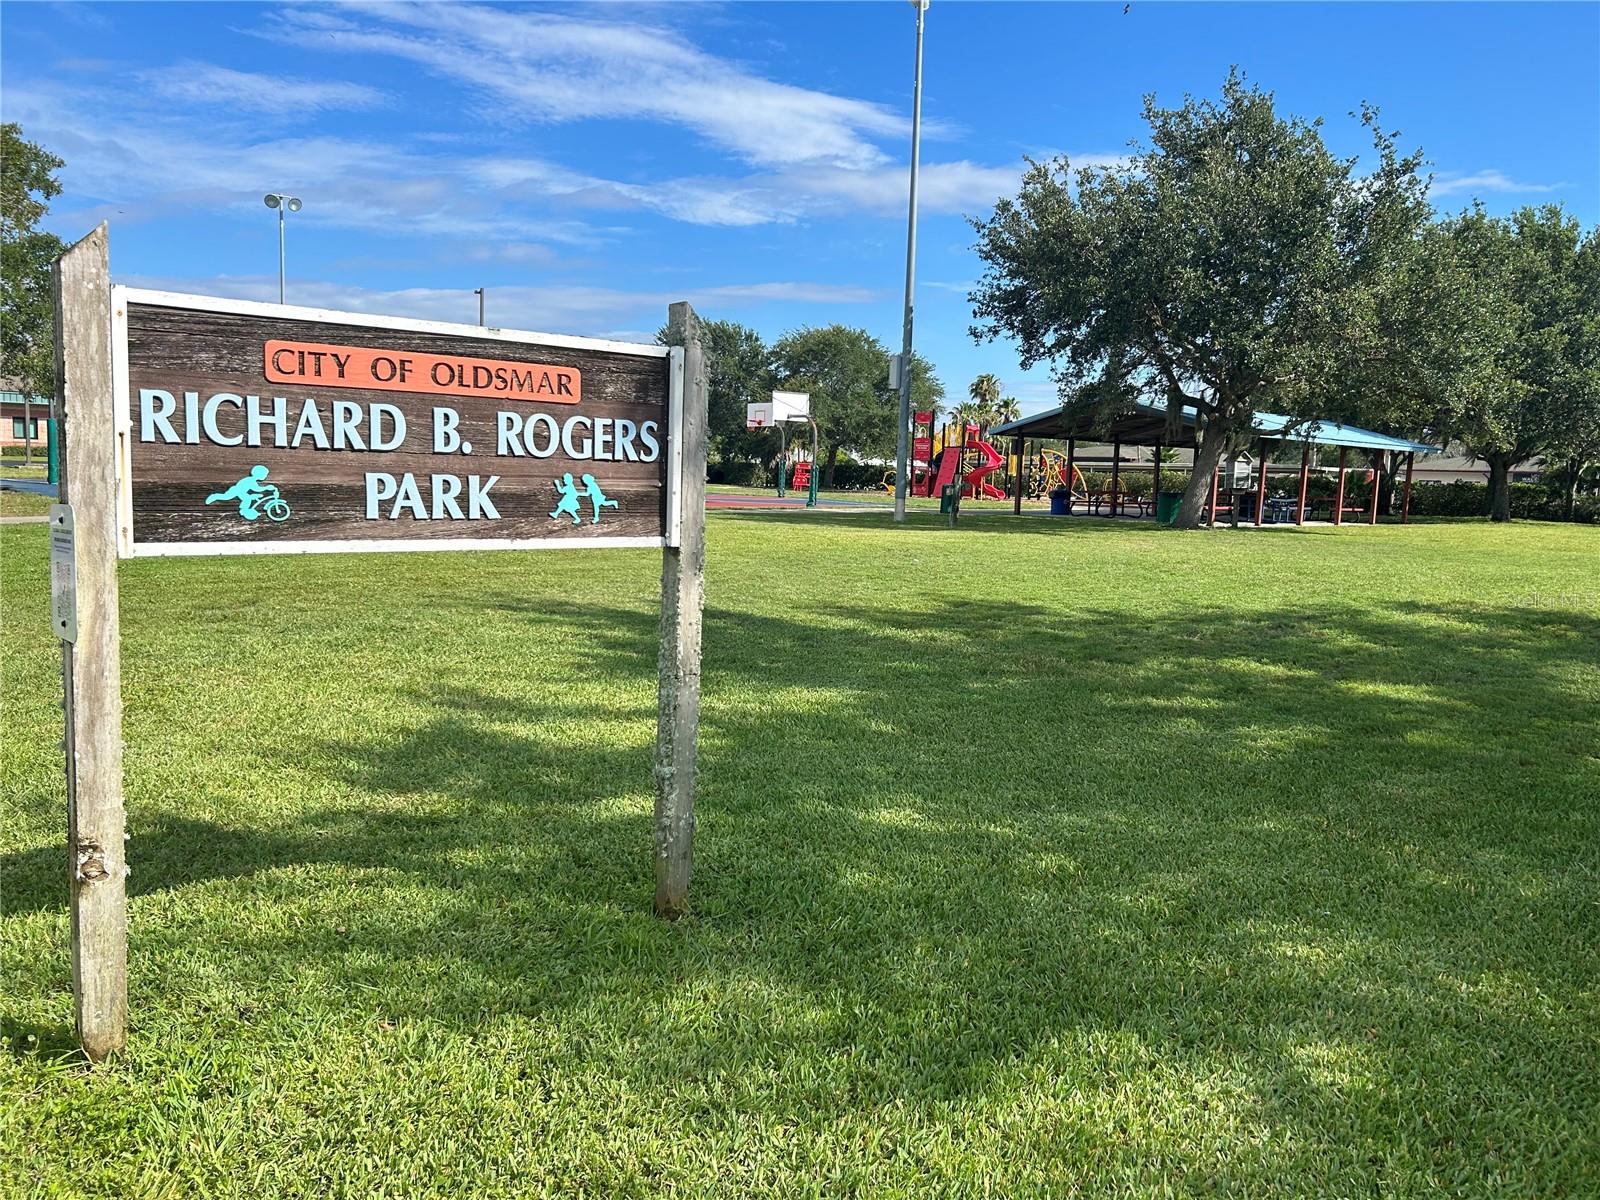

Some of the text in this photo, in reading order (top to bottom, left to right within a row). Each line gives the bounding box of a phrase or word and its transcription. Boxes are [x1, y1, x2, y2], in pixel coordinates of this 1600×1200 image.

[271, 349, 574, 397] CITY OF OLDSMAR
[139, 388, 660, 463] RICHARD B. ROGERS
[365, 472, 502, 521] PARK
